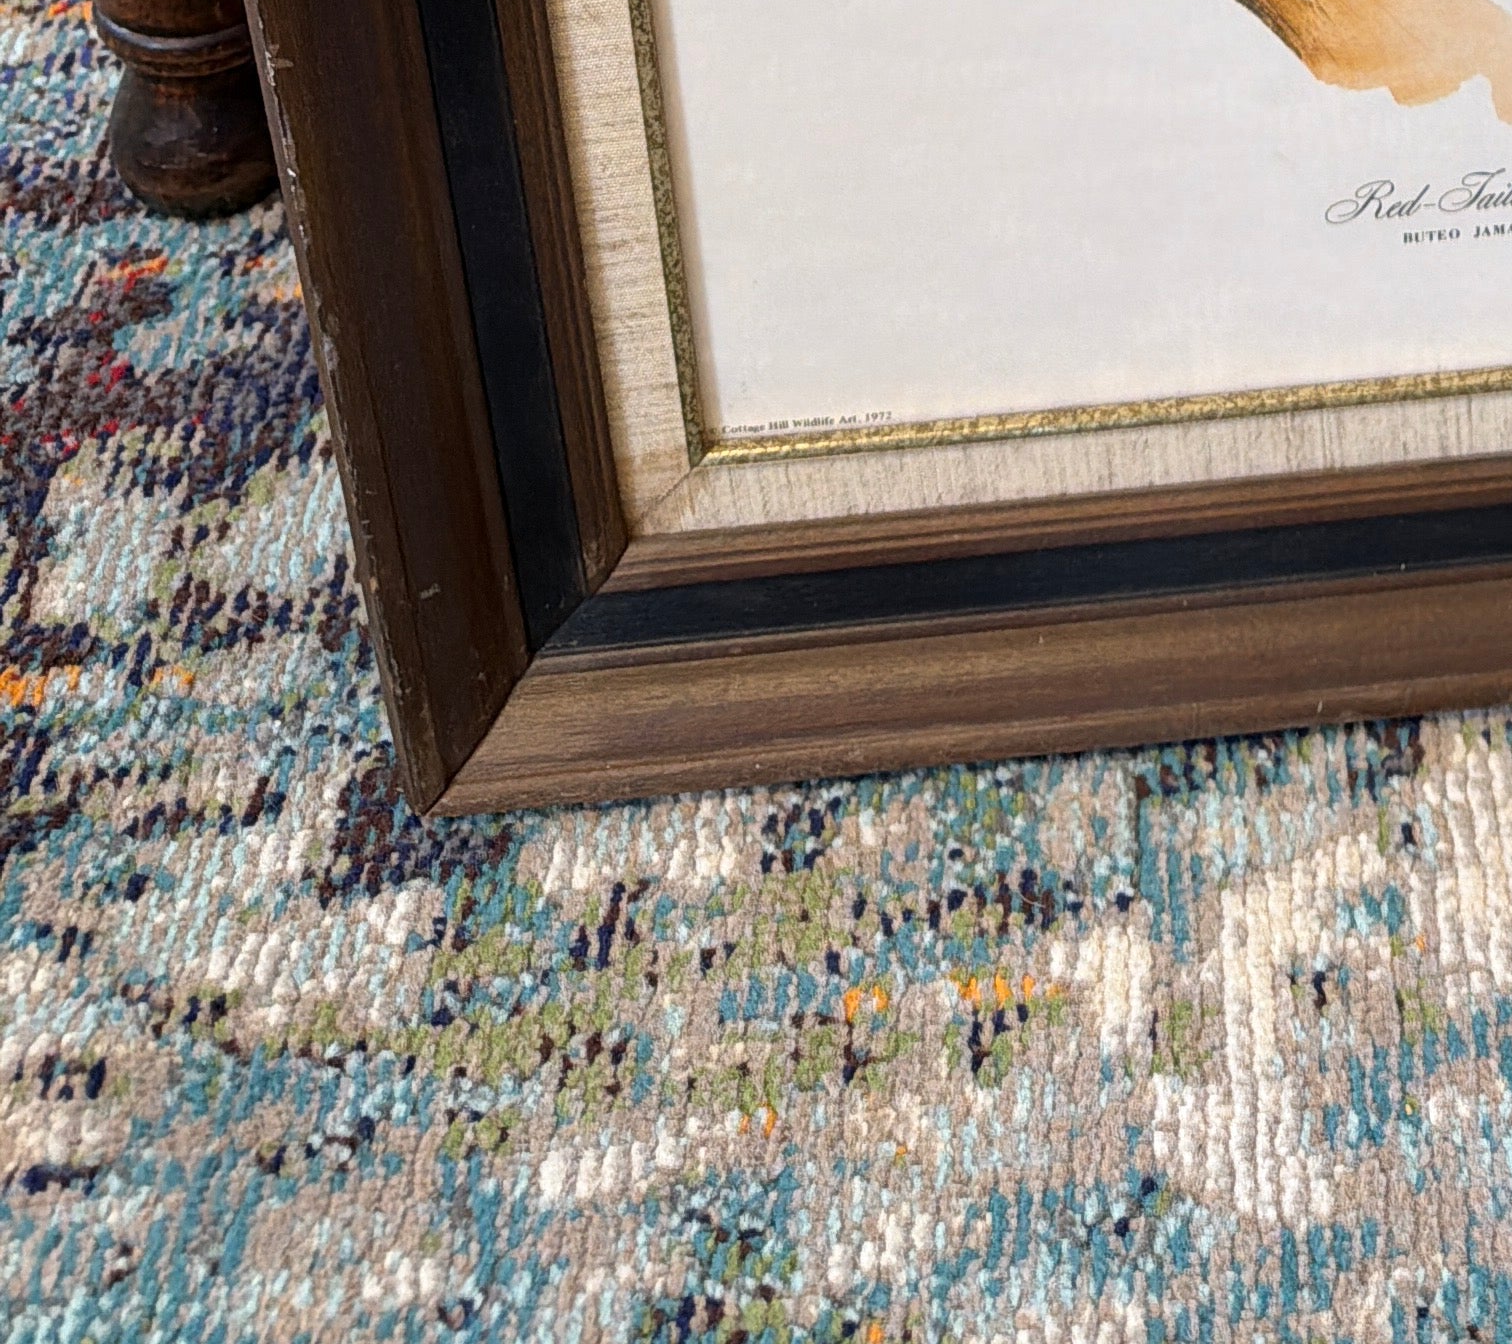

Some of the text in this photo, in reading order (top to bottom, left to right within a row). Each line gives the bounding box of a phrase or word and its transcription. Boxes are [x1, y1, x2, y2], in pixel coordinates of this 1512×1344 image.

[1402, 228, 1462, 245] BUTEO
[722, 422, 766, 435] Cottage
[768, 419, 790, 431] Hill
[792, 415, 835, 429] Wildlife
